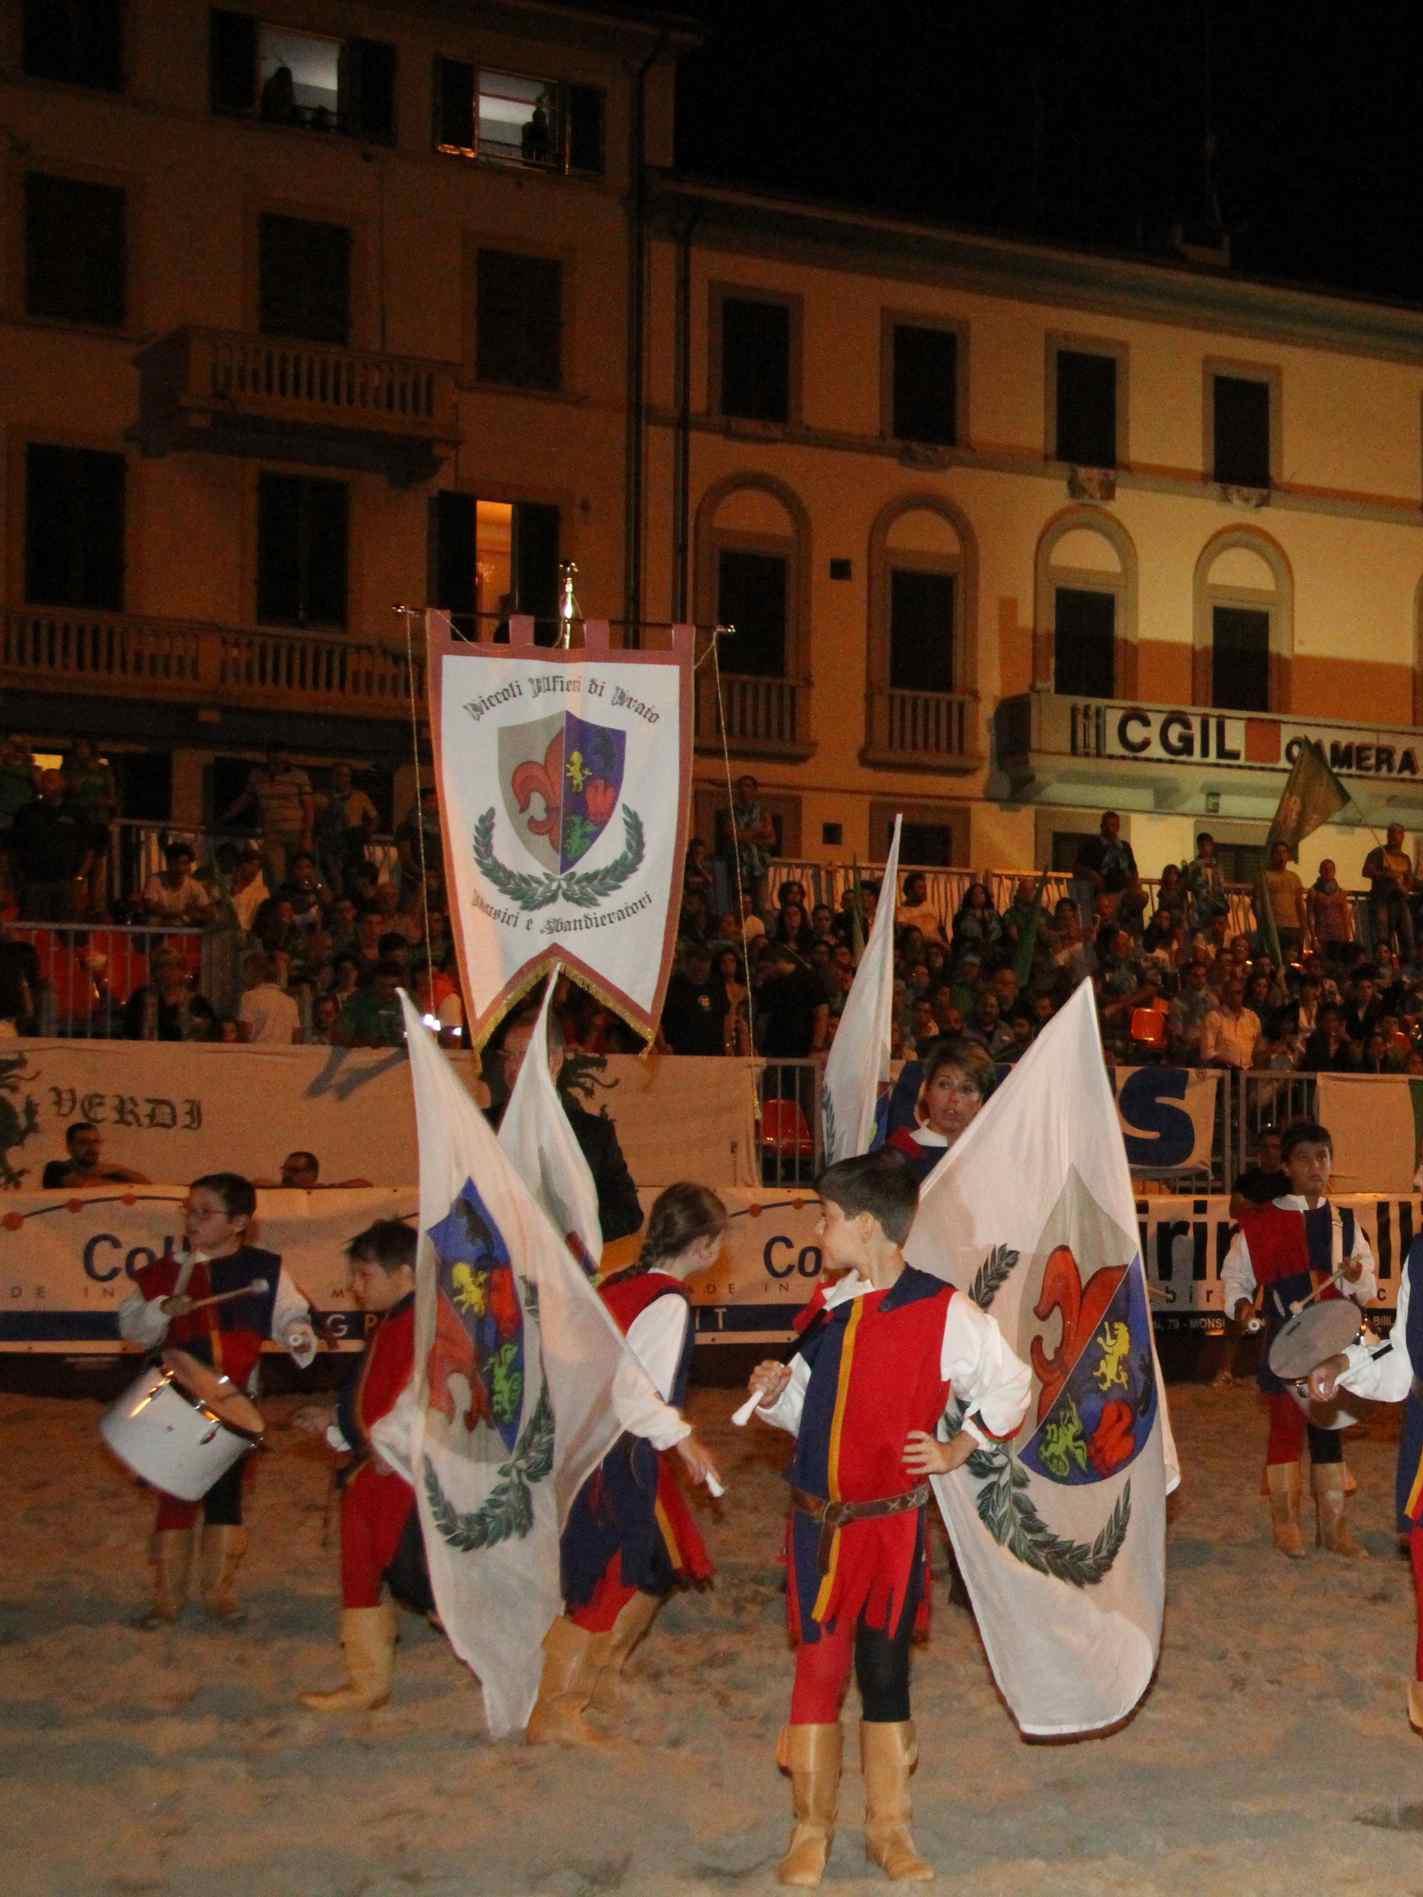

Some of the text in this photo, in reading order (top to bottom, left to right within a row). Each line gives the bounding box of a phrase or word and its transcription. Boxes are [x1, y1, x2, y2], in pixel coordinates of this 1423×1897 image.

[462, 680, 523, 721] Piccoli
[587, 678, 607, 697] di
[611, 685, 662, 725] Prato
[1117, 708, 1242, 760] CGIL
[472, 888, 655, 935] Musici e Sbandieratori
[48, 1086, 203, 1130] VERDI
